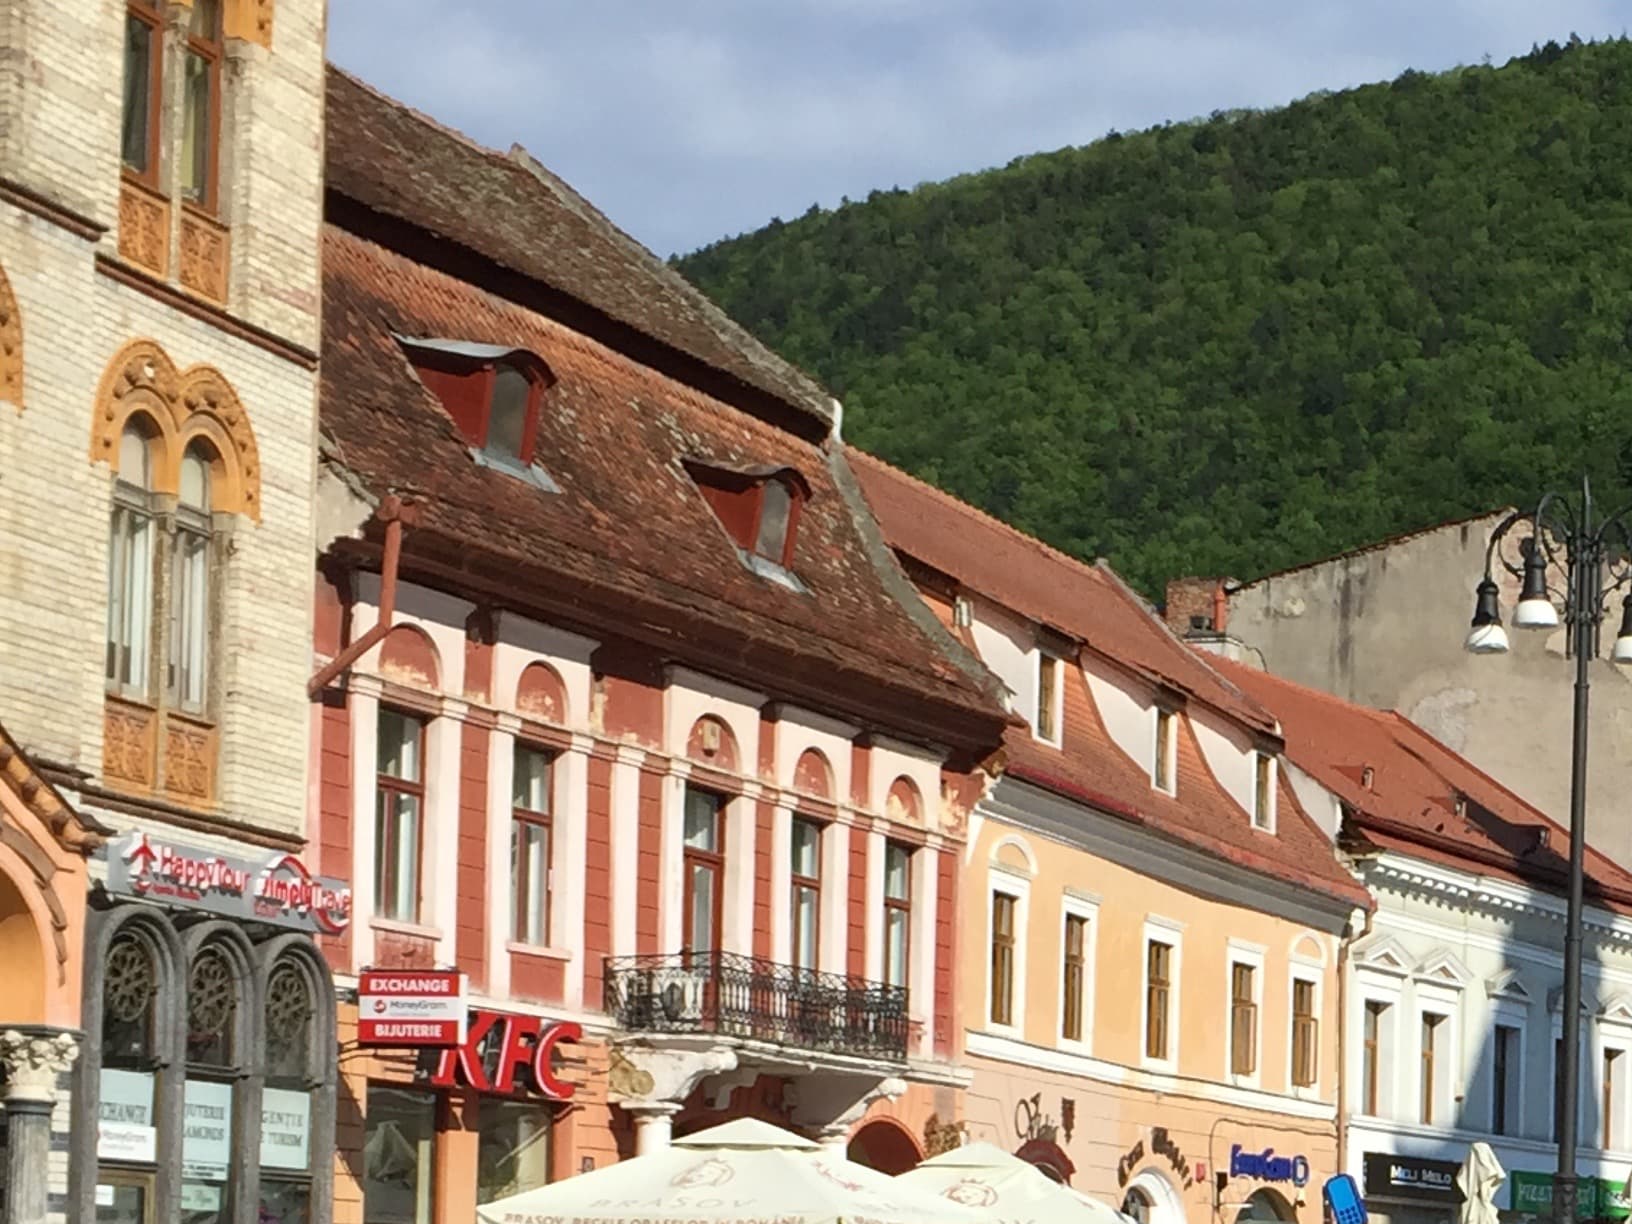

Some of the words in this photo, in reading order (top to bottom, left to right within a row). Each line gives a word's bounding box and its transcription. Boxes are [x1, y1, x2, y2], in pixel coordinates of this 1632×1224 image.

[369, 979, 450, 993] EXCHANGE
[374, 1024, 442, 1038] BIJUTERIE
[430, 1010, 583, 1099] KFC
